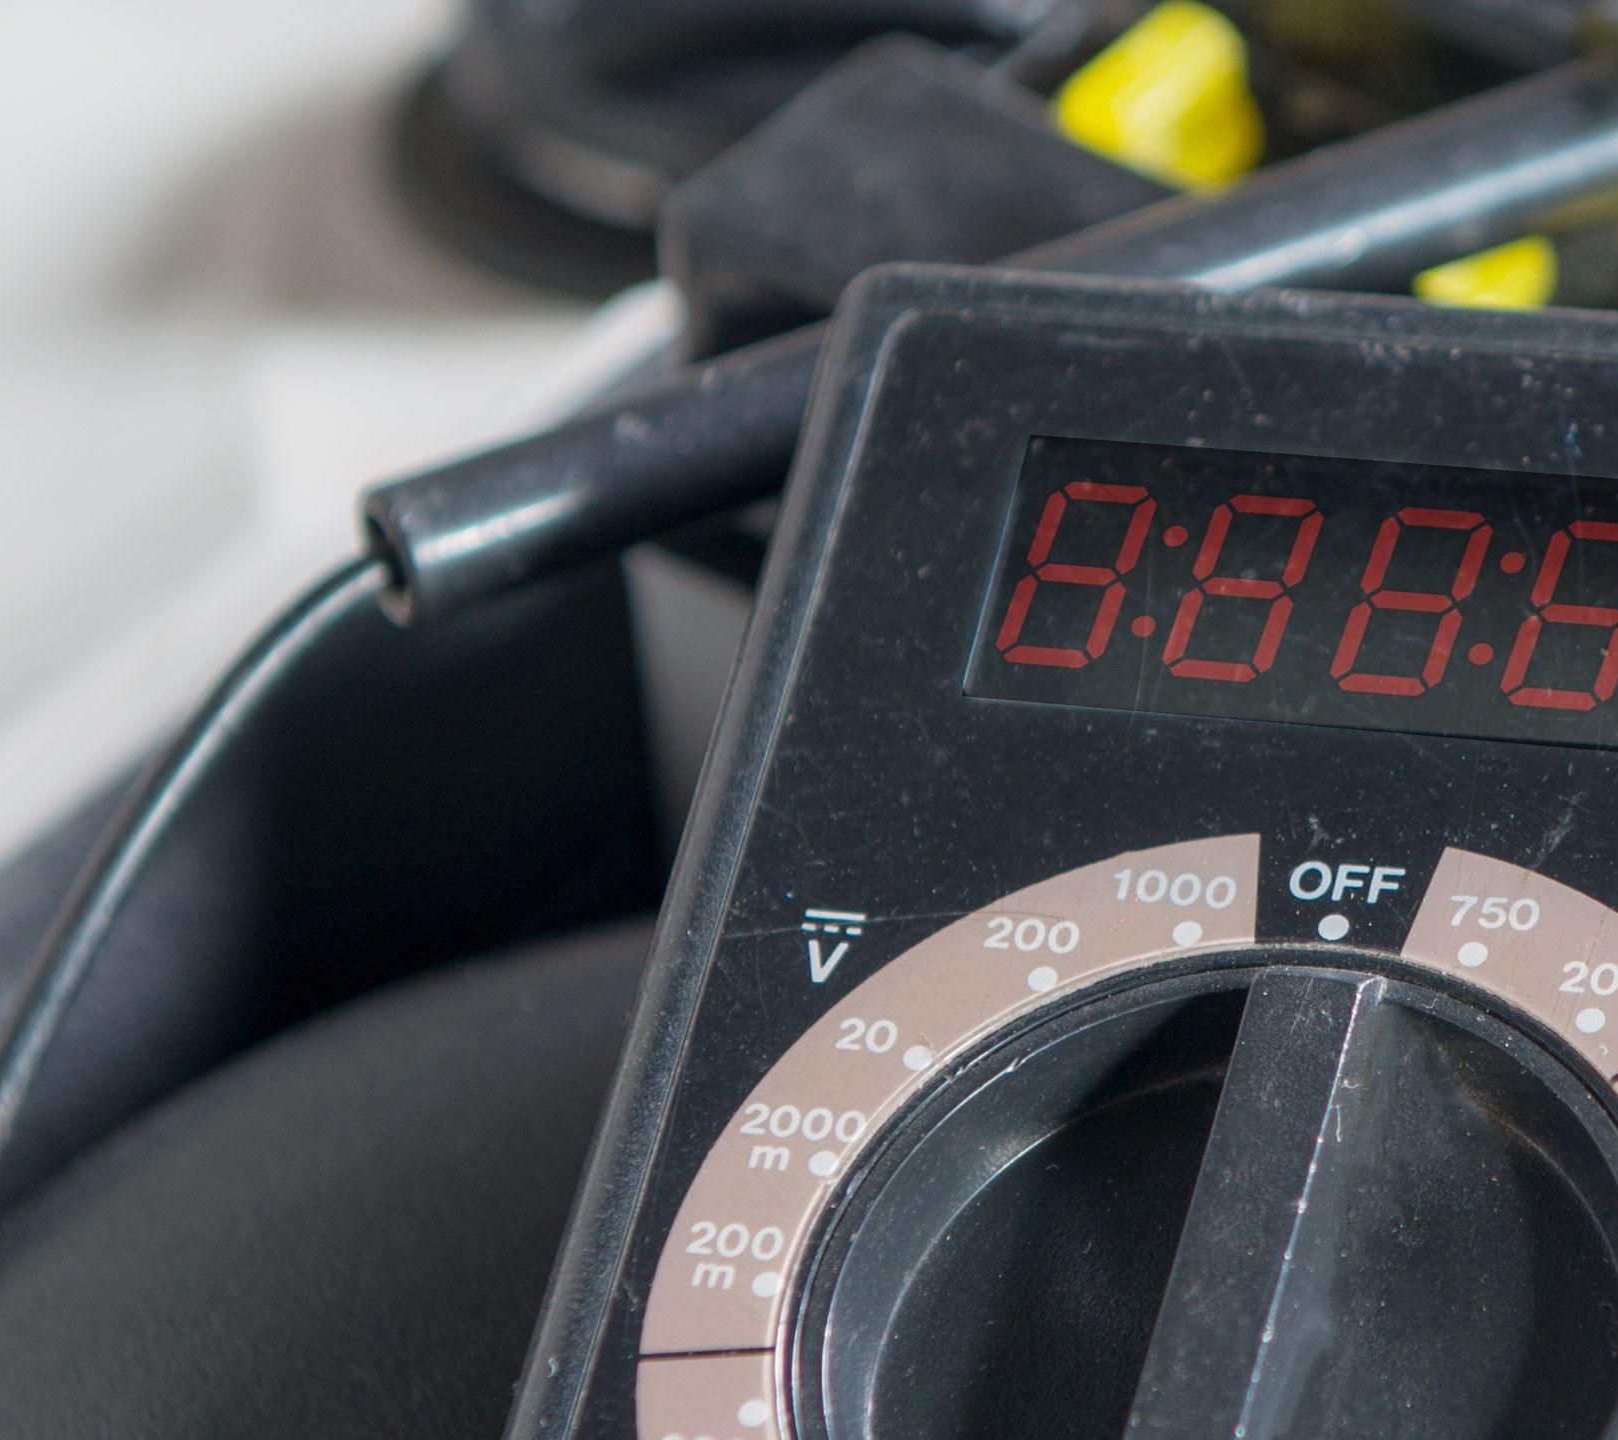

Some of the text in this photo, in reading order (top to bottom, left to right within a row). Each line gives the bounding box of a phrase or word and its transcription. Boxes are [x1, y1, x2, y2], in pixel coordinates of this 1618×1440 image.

[1114, 869, 1236, 909] 1000
[1290, 861, 1406, 903] OFF
[1451, 895, 1539, 931] 750
[984, 917, 1079, 954] 200
[836, 1018, 897, 1053] 20
[740, 1103, 867, 1143] 2000
[686, 1221, 784, 1260] 200
